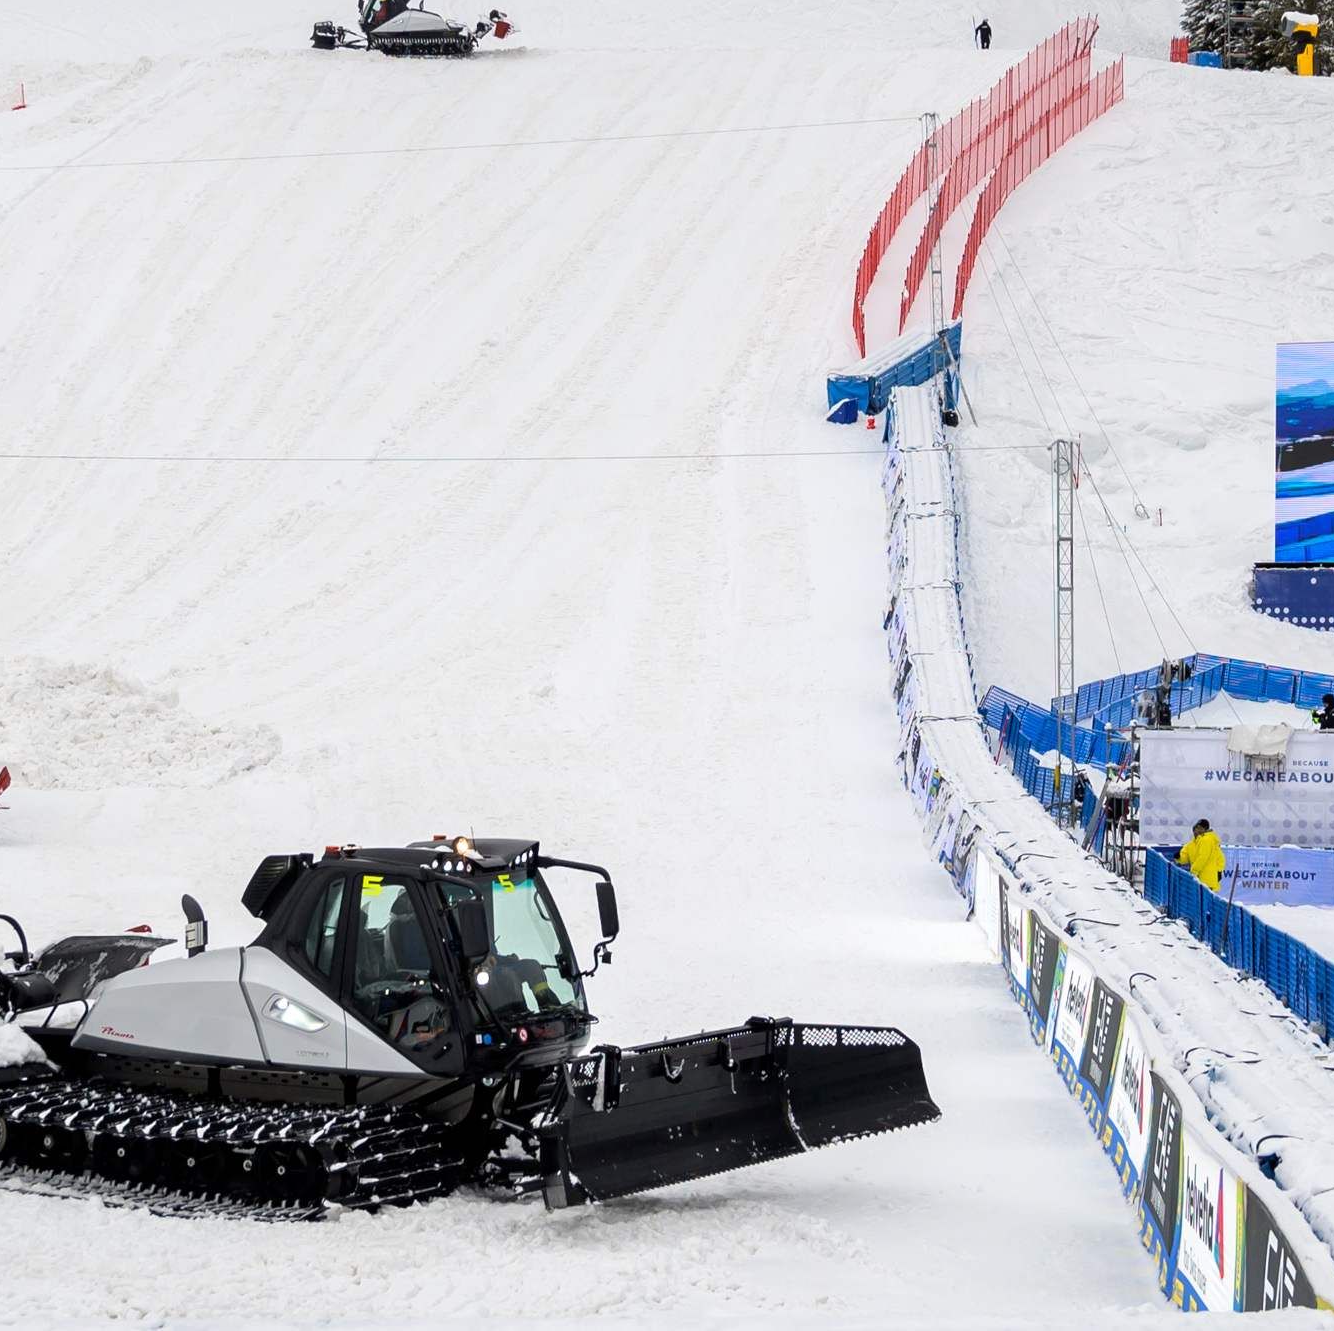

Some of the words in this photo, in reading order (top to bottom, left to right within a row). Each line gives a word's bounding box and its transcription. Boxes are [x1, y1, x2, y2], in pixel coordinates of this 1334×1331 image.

[363, 875, 384, 895] 5
[497, 874, 515, 893] 5
[1242, 880, 1290, 890] WINTER
[1092, 989, 1113, 1063] EA7
[1153, 1092, 1176, 1192] EA7
[1185, 1155, 1213, 1253] helvetia
